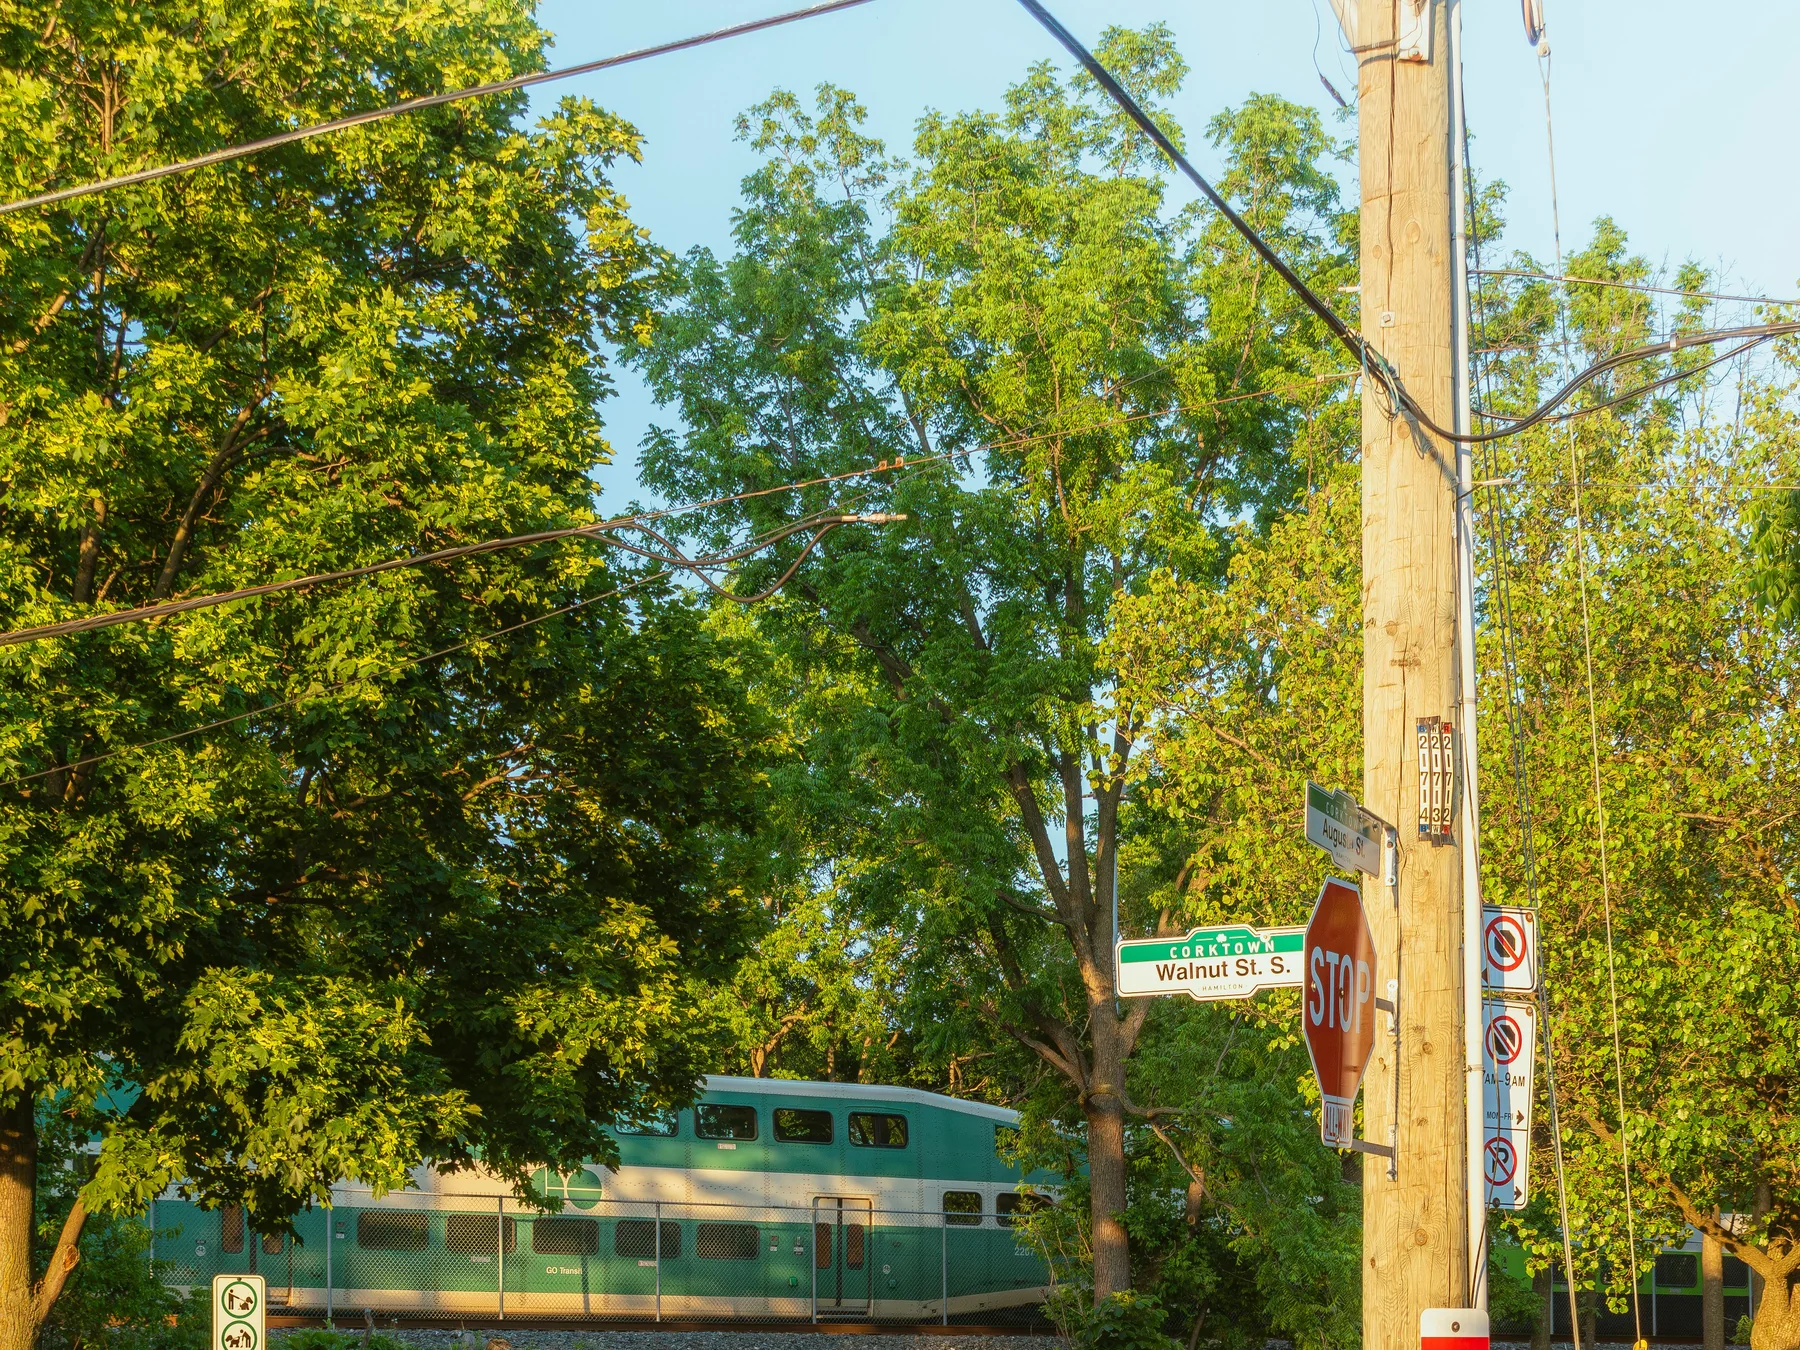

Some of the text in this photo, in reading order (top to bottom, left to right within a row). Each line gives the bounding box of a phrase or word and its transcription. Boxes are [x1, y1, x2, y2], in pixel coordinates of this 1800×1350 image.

[1169, 940, 1275, 959] CORKTOWN
[1155, 956, 1291, 982] Walnut St. S.
[1202, 983, 1244, 992] HAMILTON
[1309, 946, 1371, 1034] STOP
[546, 1266, 583, 1275] GO Transit
